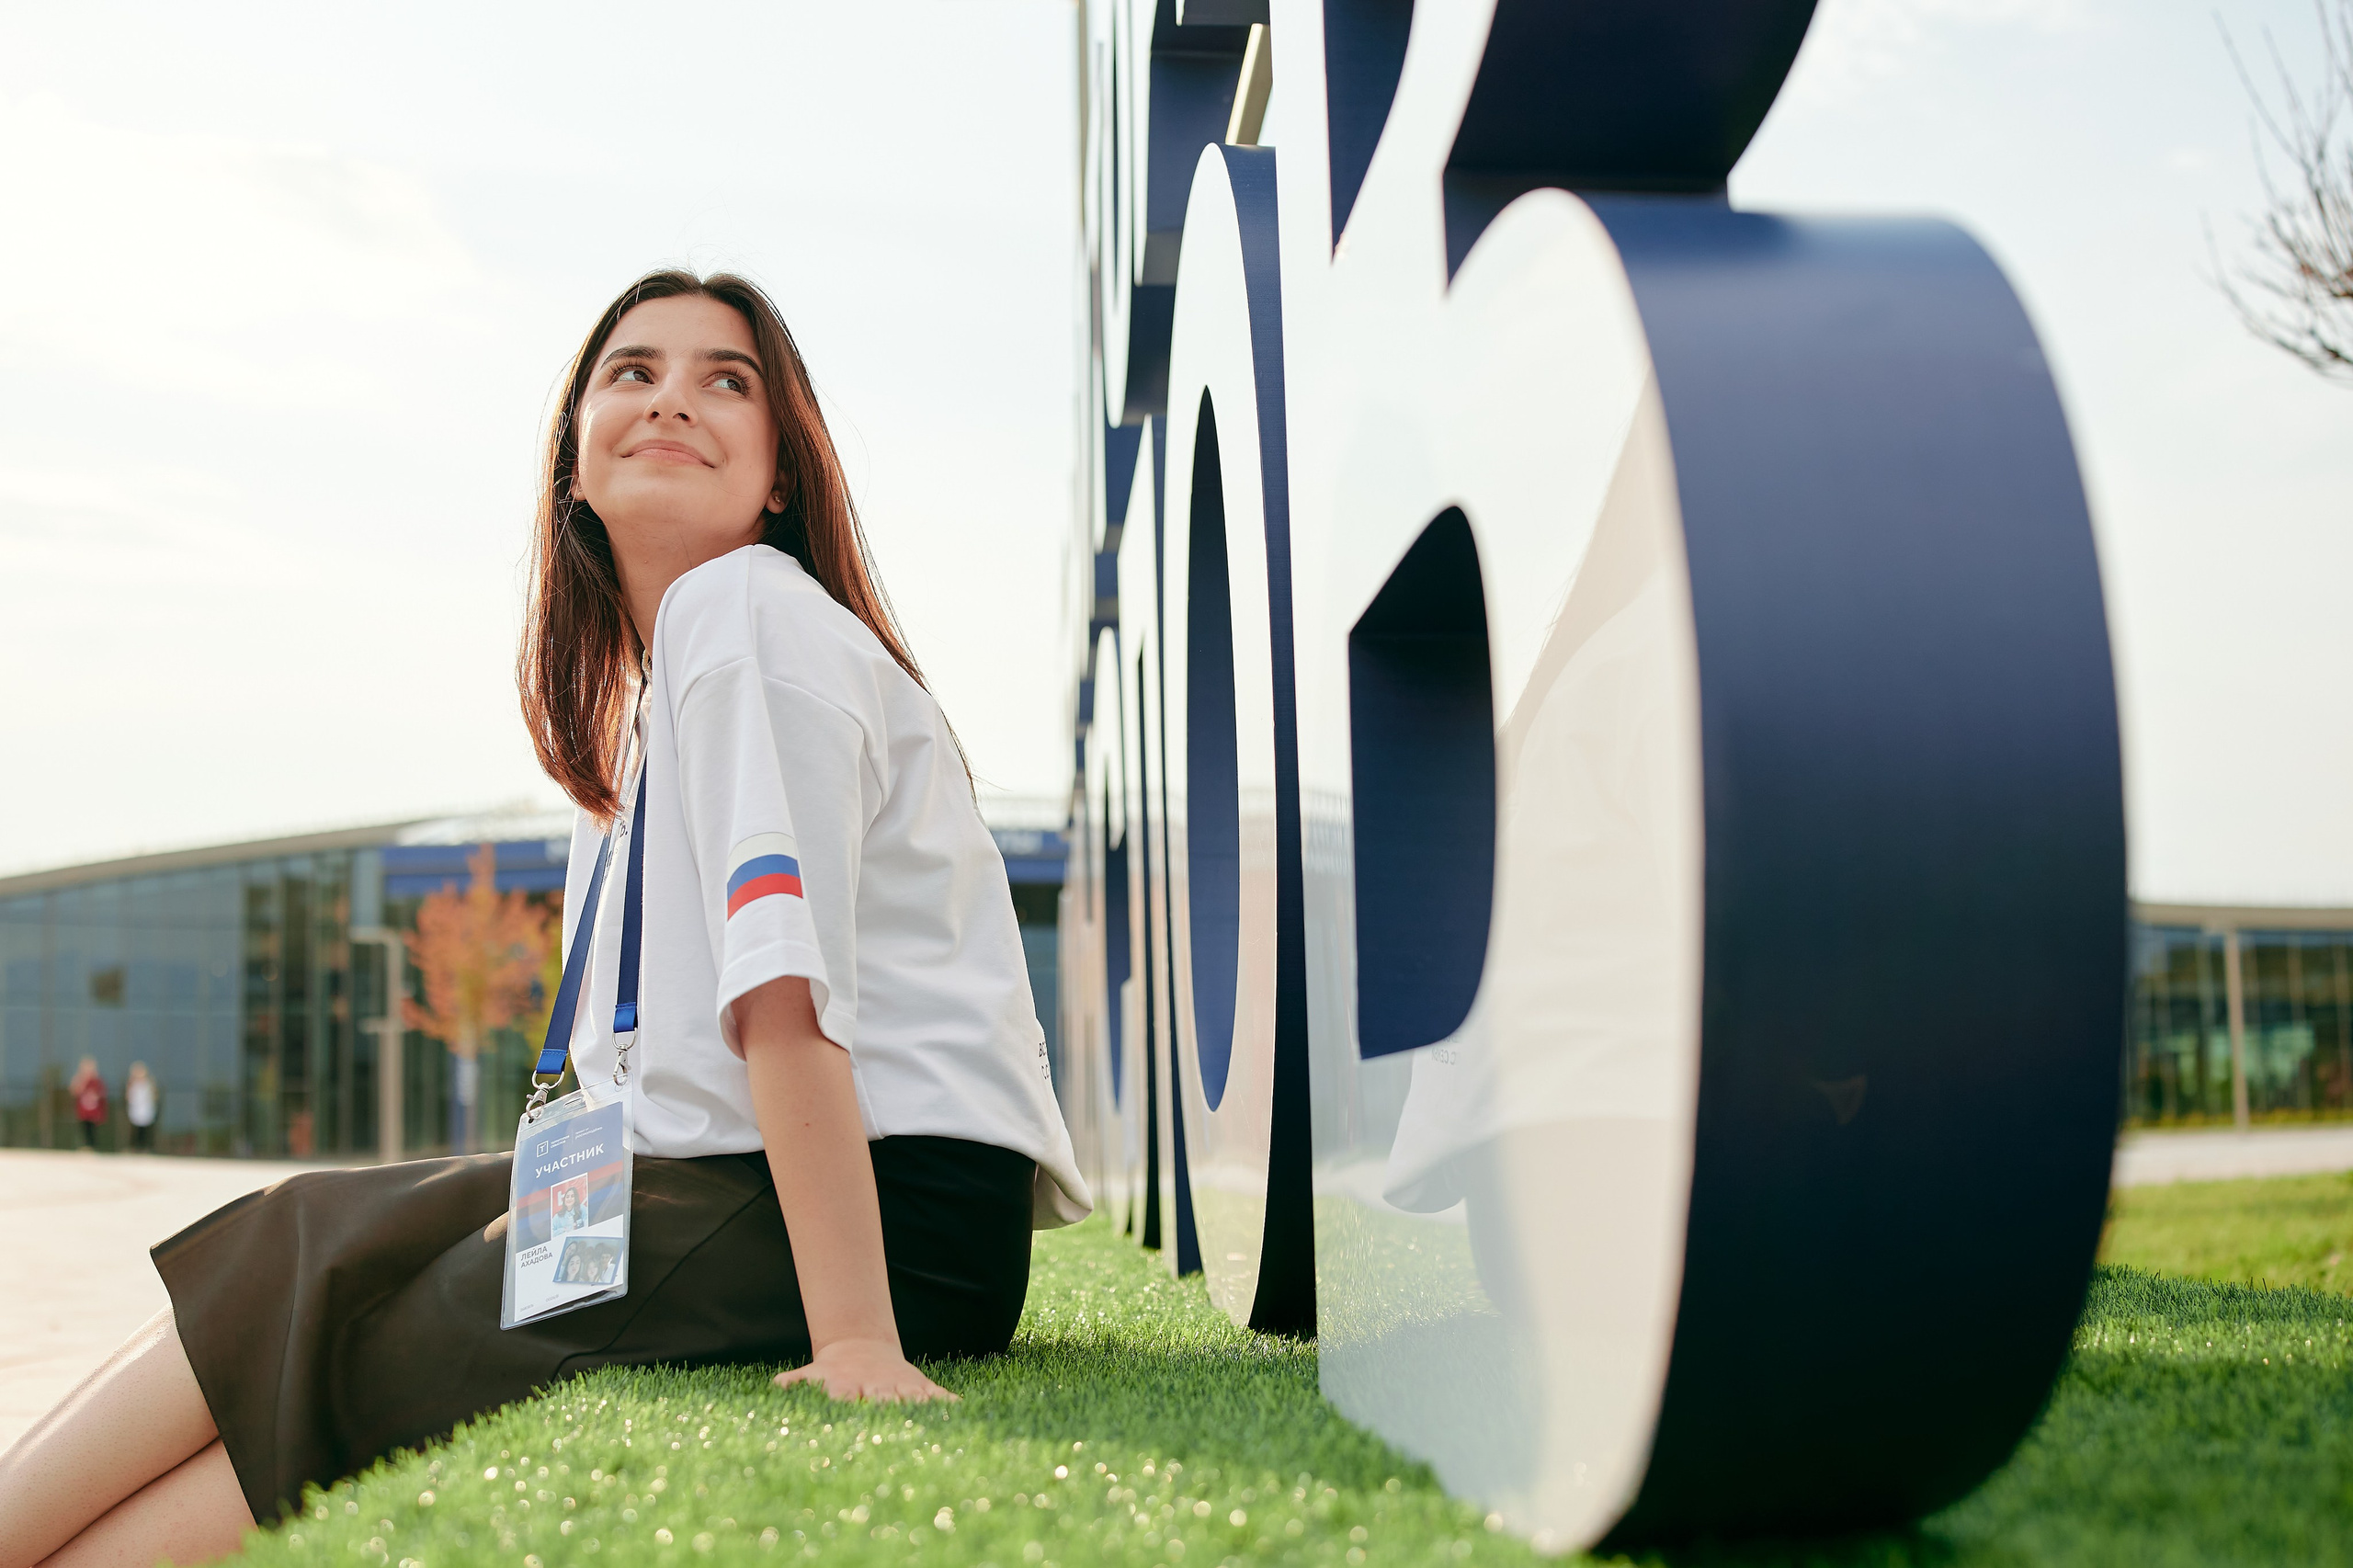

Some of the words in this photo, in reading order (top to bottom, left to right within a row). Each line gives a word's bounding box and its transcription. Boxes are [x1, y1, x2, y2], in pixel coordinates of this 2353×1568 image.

[535, 1143, 605, 1178] УЧАСТНИК
[520, 1245, 548, 1261] ЛЕЙЛА
[520, 1252, 553, 1268] АХАДОВА
